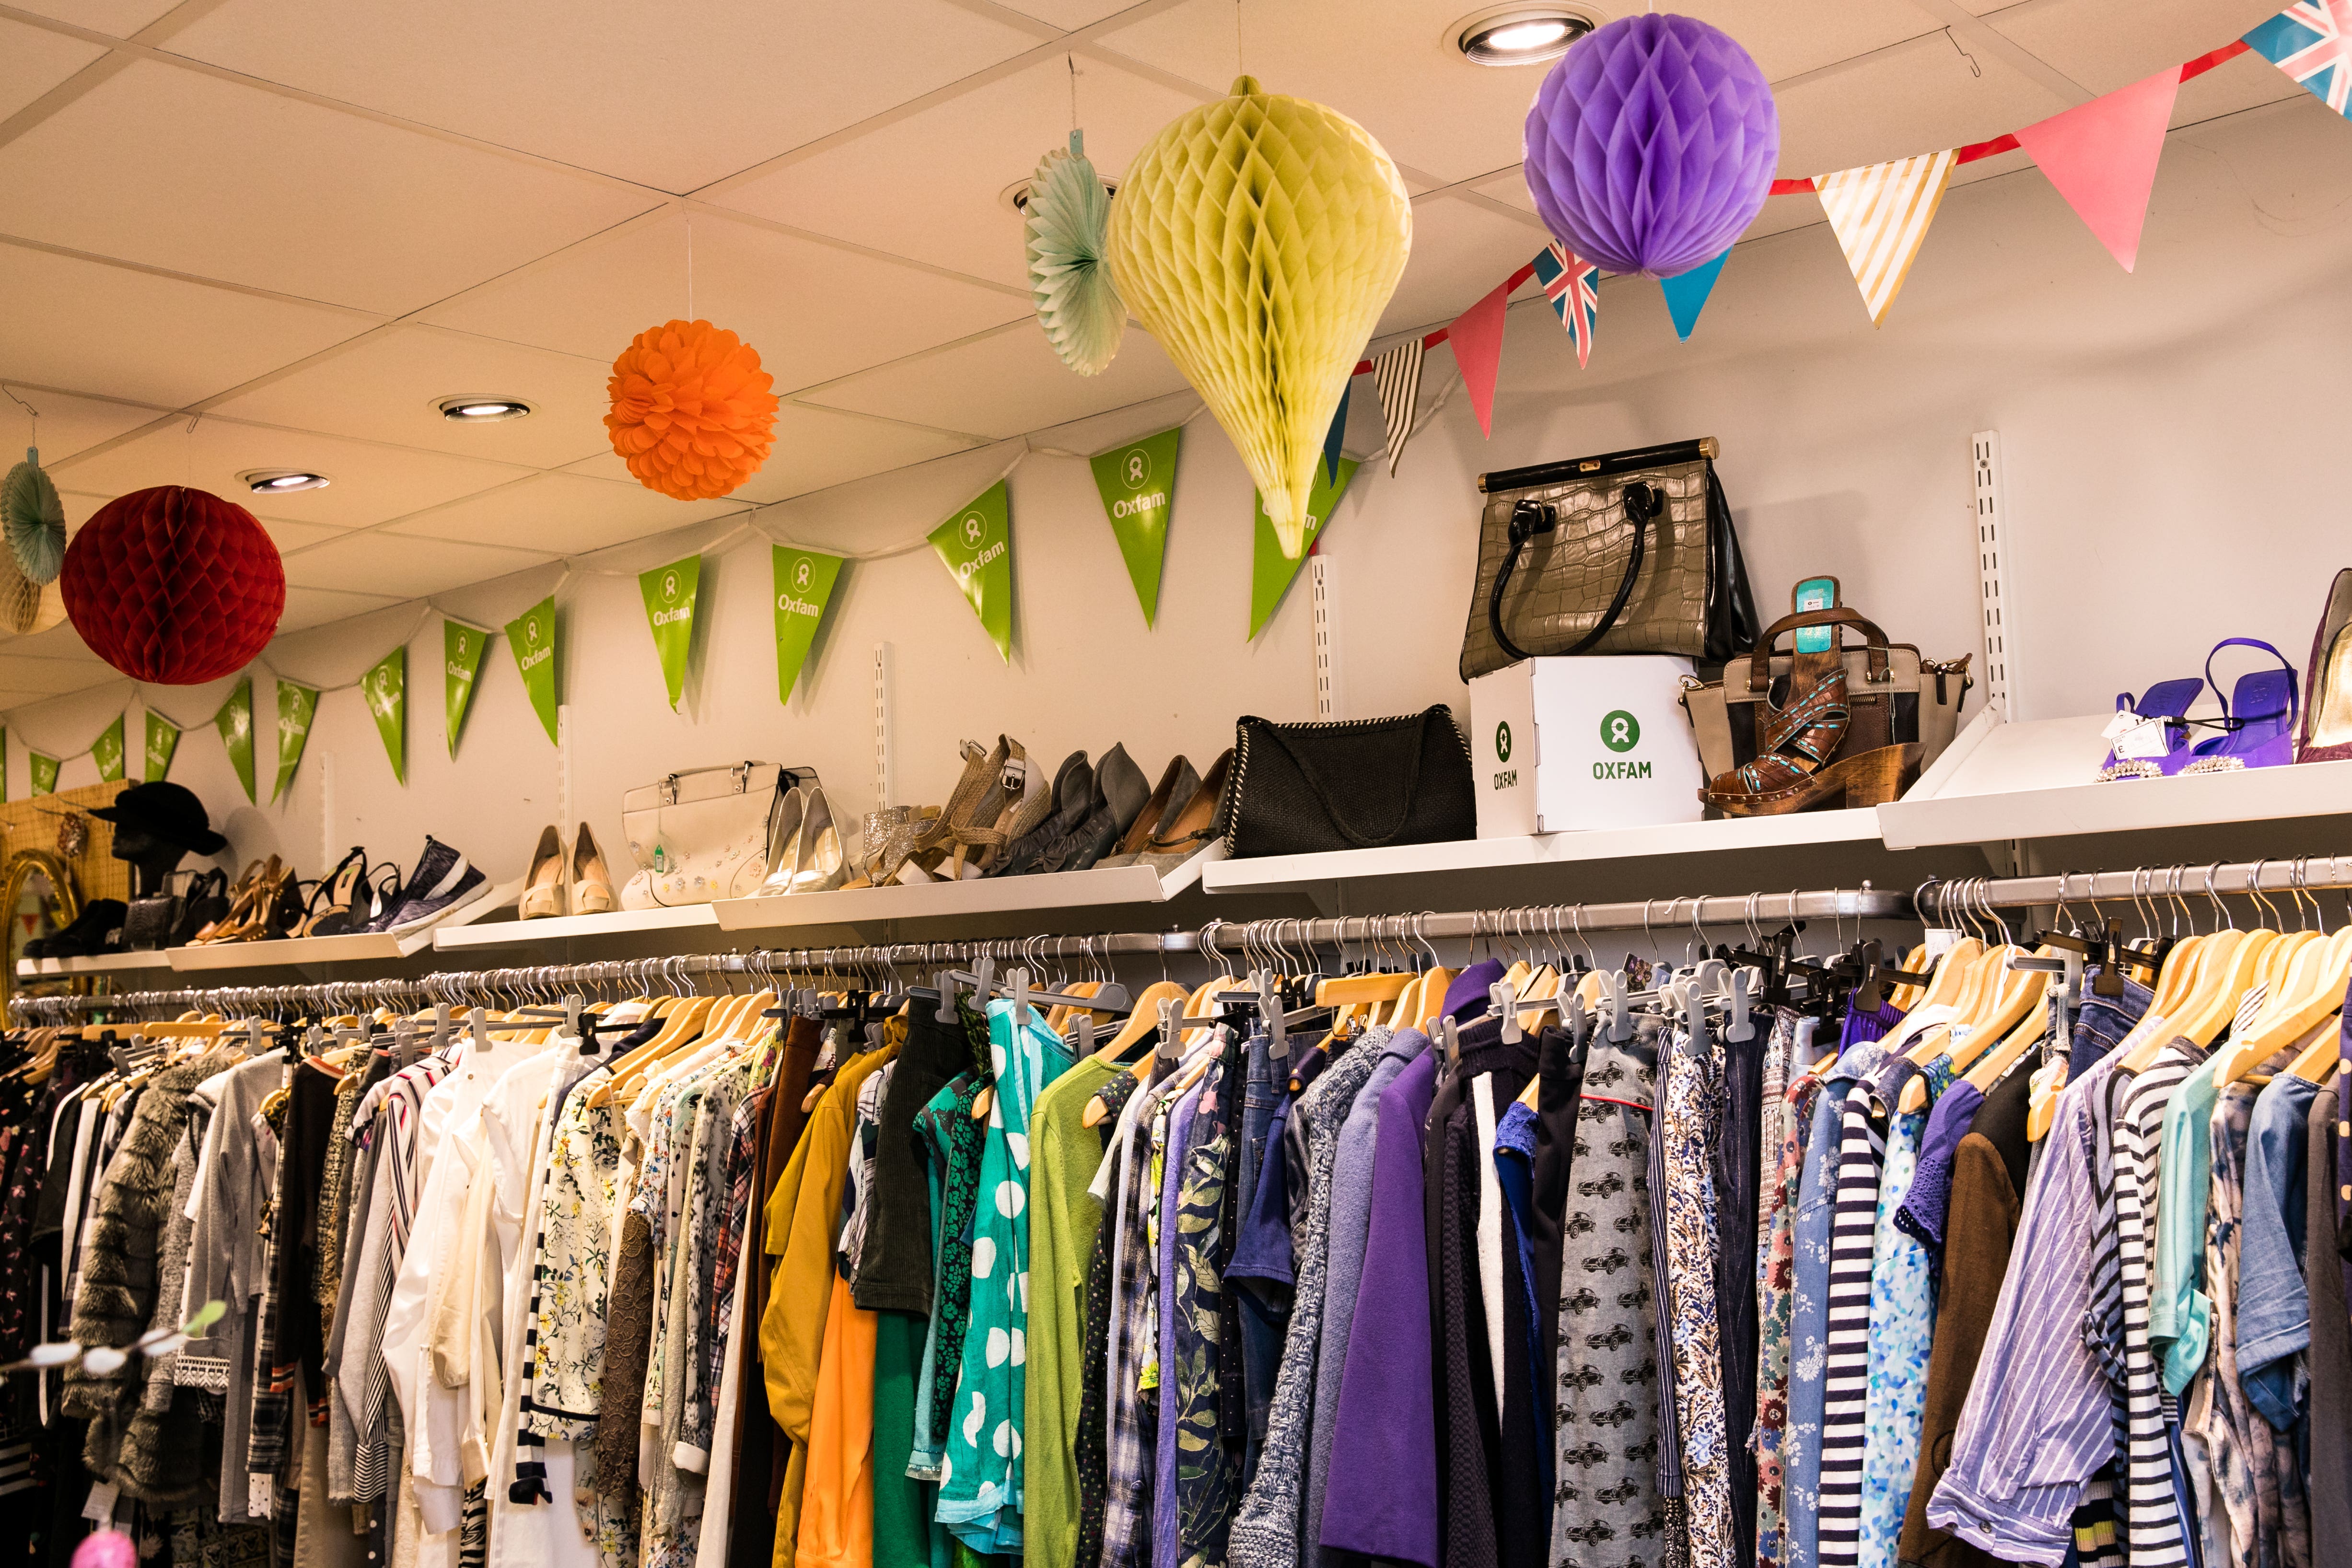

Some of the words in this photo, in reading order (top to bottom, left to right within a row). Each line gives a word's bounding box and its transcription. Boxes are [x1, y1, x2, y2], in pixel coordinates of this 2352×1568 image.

[1113, 492, 1165, 519] Oxfam
[959, 541, 1004, 579] Oxfam
[653, 606, 690, 626] Oxfam
[778, 594, 818, 617] Oxfam
[521, 646, 551, 671] Oxfam
[448, 661, 472, 682] Oxfam
[1494, 769, 1517, 790] OXFAM
[1593, 761, 1652, 779] OXFAM
